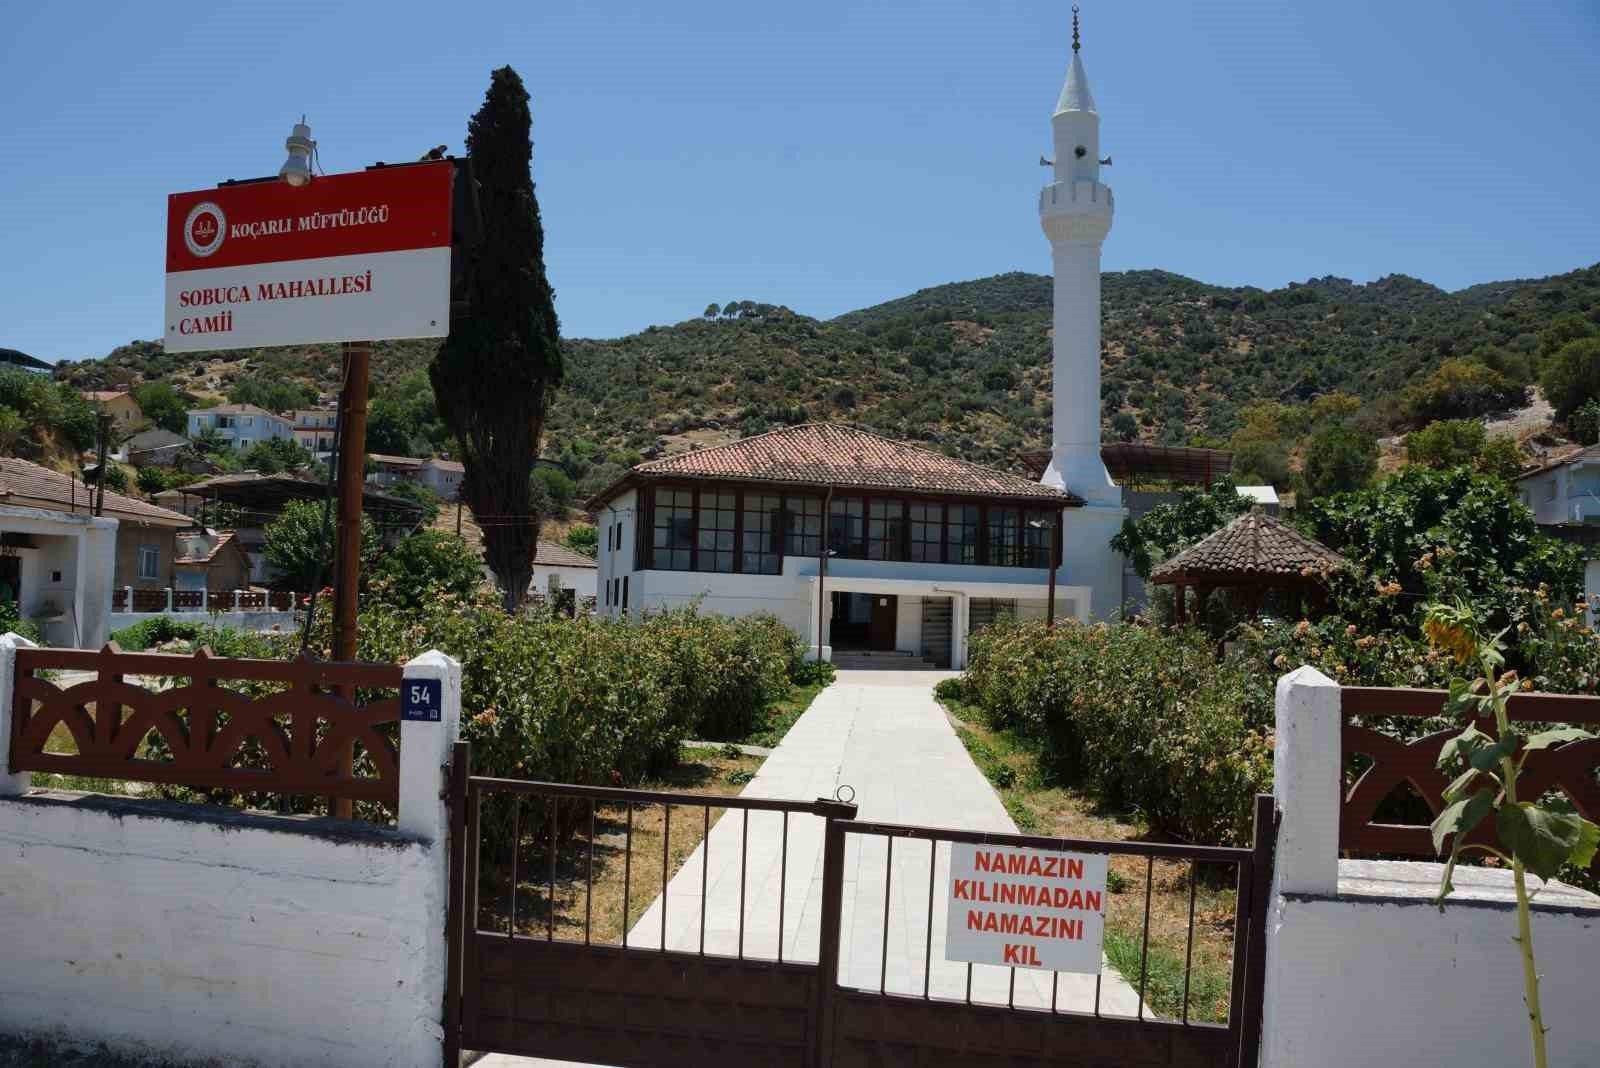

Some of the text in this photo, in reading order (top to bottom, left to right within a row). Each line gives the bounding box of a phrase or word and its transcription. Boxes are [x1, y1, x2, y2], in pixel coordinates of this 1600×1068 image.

[231, 218, 292, 239] KOÇARLI
[297, 204, 390, 231] MÜFTÜLÜĞÜ
[179, 270, 373, 308] SOBUCA MAHALLESİ
[179, 311, 233, 335] CAMİİ
[411, 686, 430, 704] 54
[975, 851, 1084, 880] NAMAZIN
[953, 879, 1102, 912] KILINMADAN
[967, 910, 1084, 940] NAMAZINI
[1003, 943, 1042, 966] KIL
